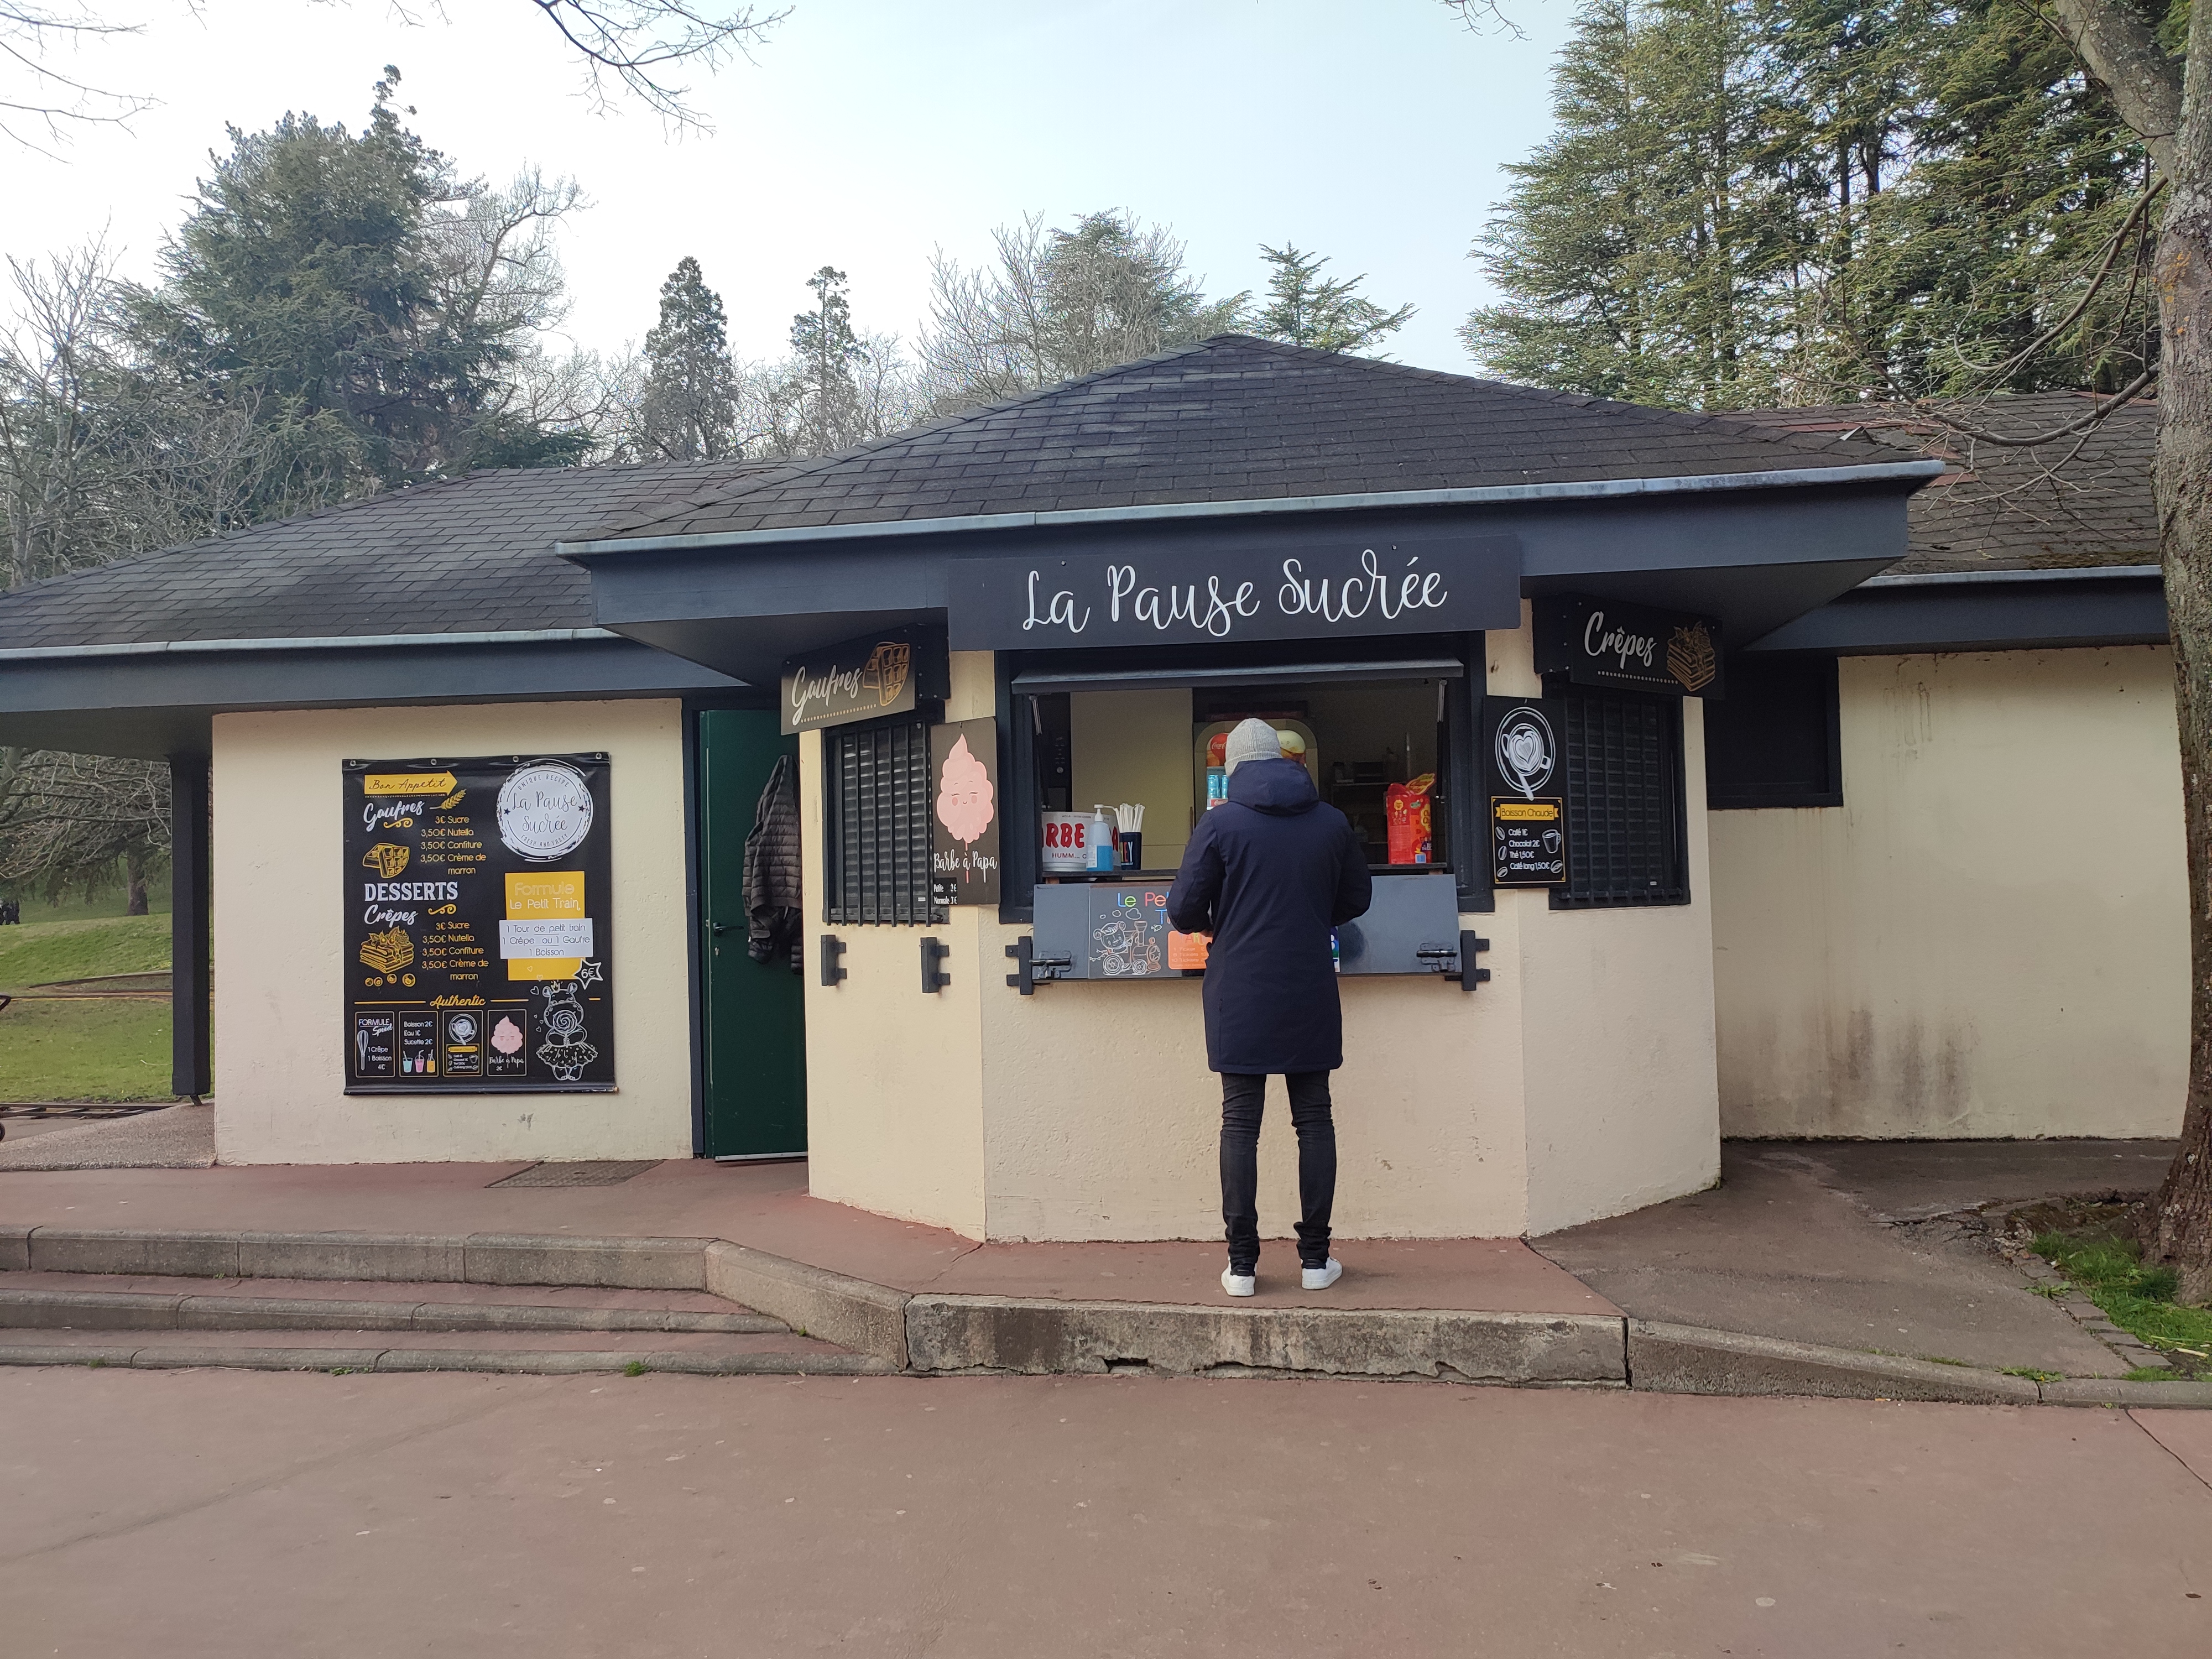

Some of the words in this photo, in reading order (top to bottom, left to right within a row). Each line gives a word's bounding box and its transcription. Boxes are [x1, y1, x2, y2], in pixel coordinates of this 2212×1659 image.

[1022, 570, 1090, 634] La
[1105, 564, 1260, 637] Pause
[1278, 549, 1448, 623] Sucrée
[1584, 611, 1657, 669] Crêpes
[791, 664, 864, 726] Gaufres
[369, 776, 395, 790] Bon
[517, 775, 541, 790] UNIQUE
[546, 774, 570, 787] RECIPE
[512, 792, 531, 811] La
[535, 791, 577, 812] Pause
[363, 801, 425, 832] Gaufres
[1501, 808, 1526, 817] Boisson
[1527, 808, 1553, 817] Chaude
[447, 815, 469, 824] Sucre
[522, 813, 568, 834] Sucrée
[421, 829, 446, 837] 3,50€
[1042, 823, 1085, 848] RBE
[420, 841, 445, 851] 3,50€
[521, 834, 536, 846] FRESH
[420, 854, 445, 864] 3,50€
[447, 853, 474, 862] Crème
[1509, 850, 1519, 858] Thé
[933, 849, 960, 873] Barbe
[963, 852, 971, 870] à
[972, 851, 997, 883] Papa
[364, 881, 458, 901] DESSERTS
[515, 881, 575, 896] Formule
[510, 899, 522, 909] Le
[528, 899, 549, 909] Petit
[552, 898, 581, 911] Train
[1117, 893, 1136, 907] Le
[364, 904, 419, 928] Crêpes
[507, 925, 510, 933] 1
[513, 925, 530, 933] Tour
[534, 924, 545, 932] de
[549, 924, 566, 933] petit
[422, 935, 447, 945] 3,50€
[448, 934, 475, 942] Nutella
[509, 937, 535, 946] Crêpe
[422, 948, 447, 957] 3,50€
[448, 947, 484, 955] Confiture
[536, 948, 564, 956] Boisson
[421, 961, 447, 971] 3,50€
[449, 958, 476, 967] Crème
[581, 968, 596, 978] 6€
[430, 995, 486, 1009] Authentic
[372, 1023, 393, 1037] Speed
[489, 1056, 504, 1065] Barbe
[511, 1056, 525, 1068] Papa
